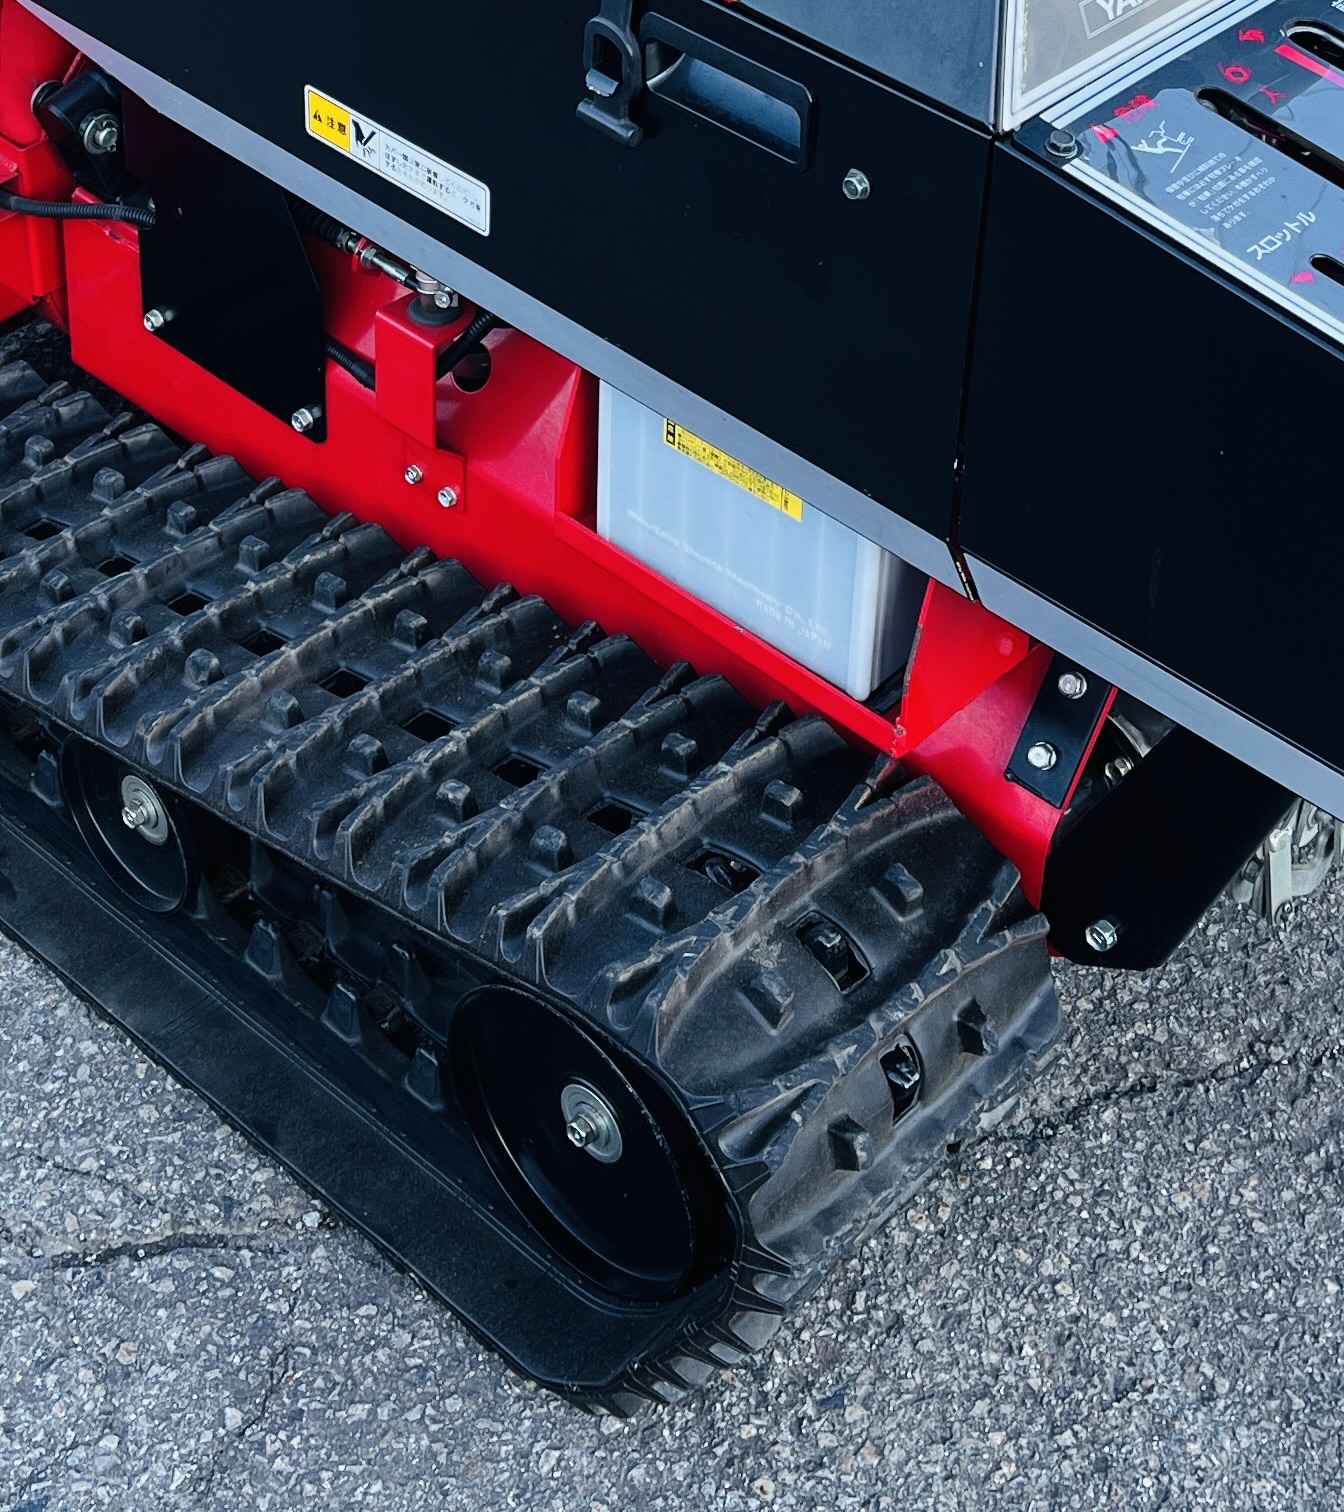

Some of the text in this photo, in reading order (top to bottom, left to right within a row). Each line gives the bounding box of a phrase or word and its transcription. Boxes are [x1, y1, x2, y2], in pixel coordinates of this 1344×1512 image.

[326, 115, 347, 136] 注意
[1246, 209, 1317, 261] スロットル
